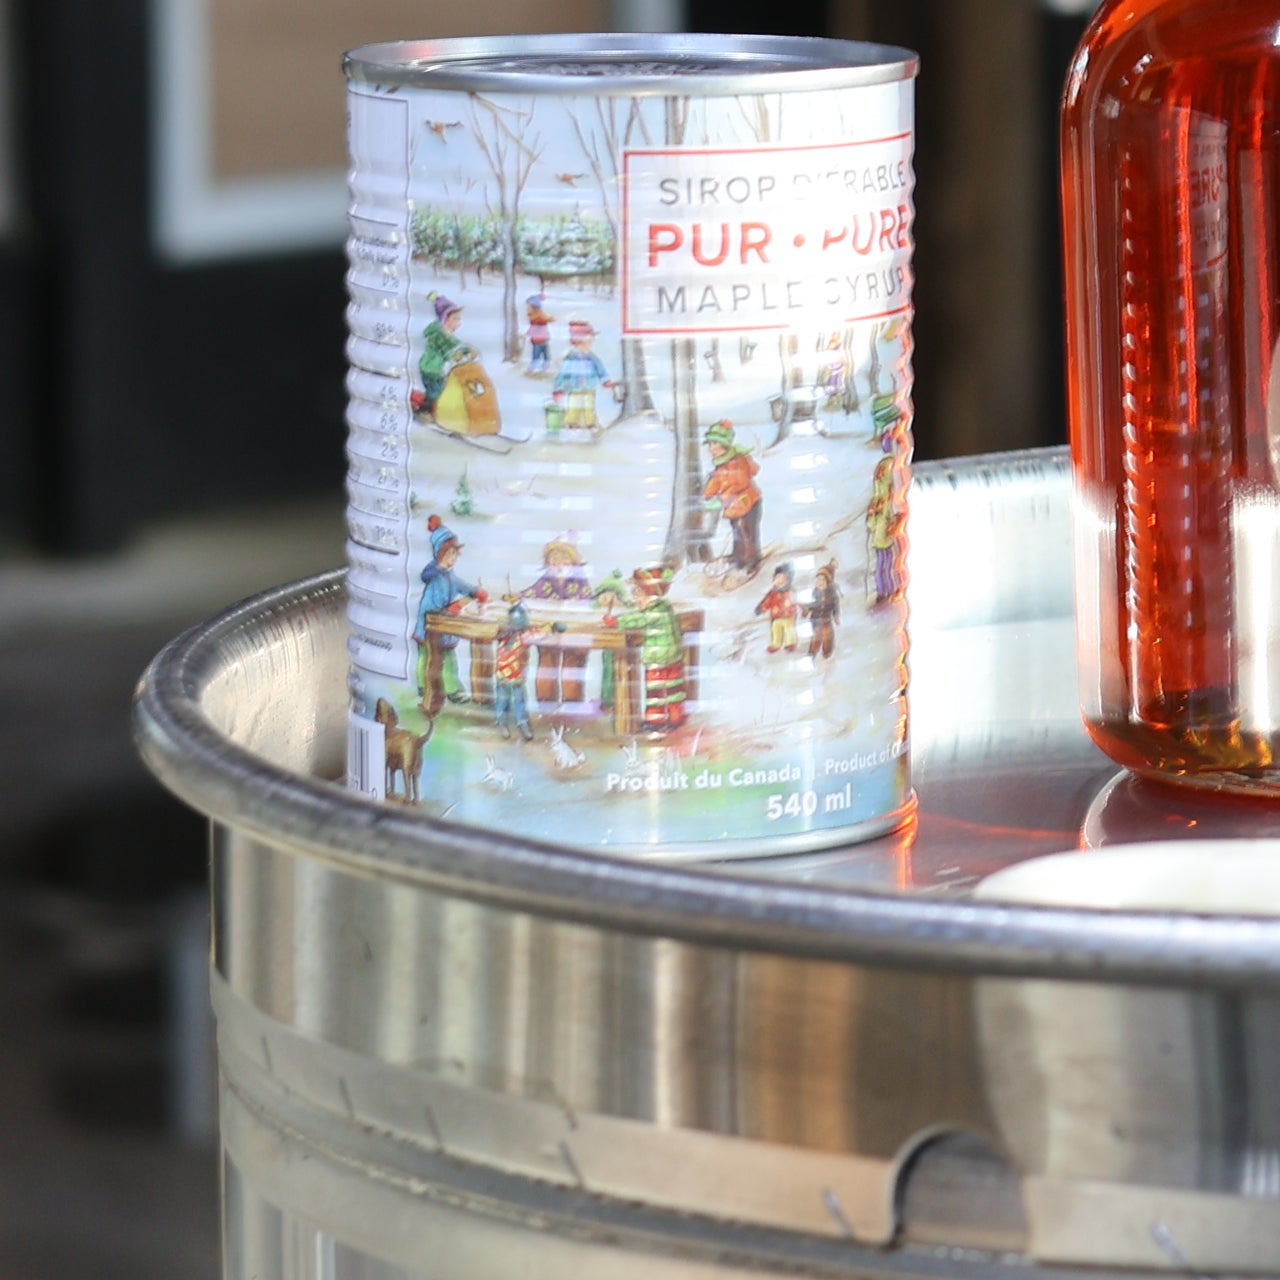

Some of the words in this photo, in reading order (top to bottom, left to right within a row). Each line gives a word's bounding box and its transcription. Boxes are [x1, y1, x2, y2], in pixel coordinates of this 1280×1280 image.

[659, 176, 776, 206] SIROP
[648, 222, 772, 268] PUR
[822, 204, 909, 255] PURE
[657, 282, 802, 314] MAPLE
[825, 266, 906, 306] SYRUP
[825, 751, 877, 776] Product
[879, 743, 891, 763] of
[606, 770, 689, 792] Produit
[695, 770, 723, 789] du
[728, 763, 801, 787] Canada
[766, 790, 818, 821] 540
[824, 783, 852, 813] ml
